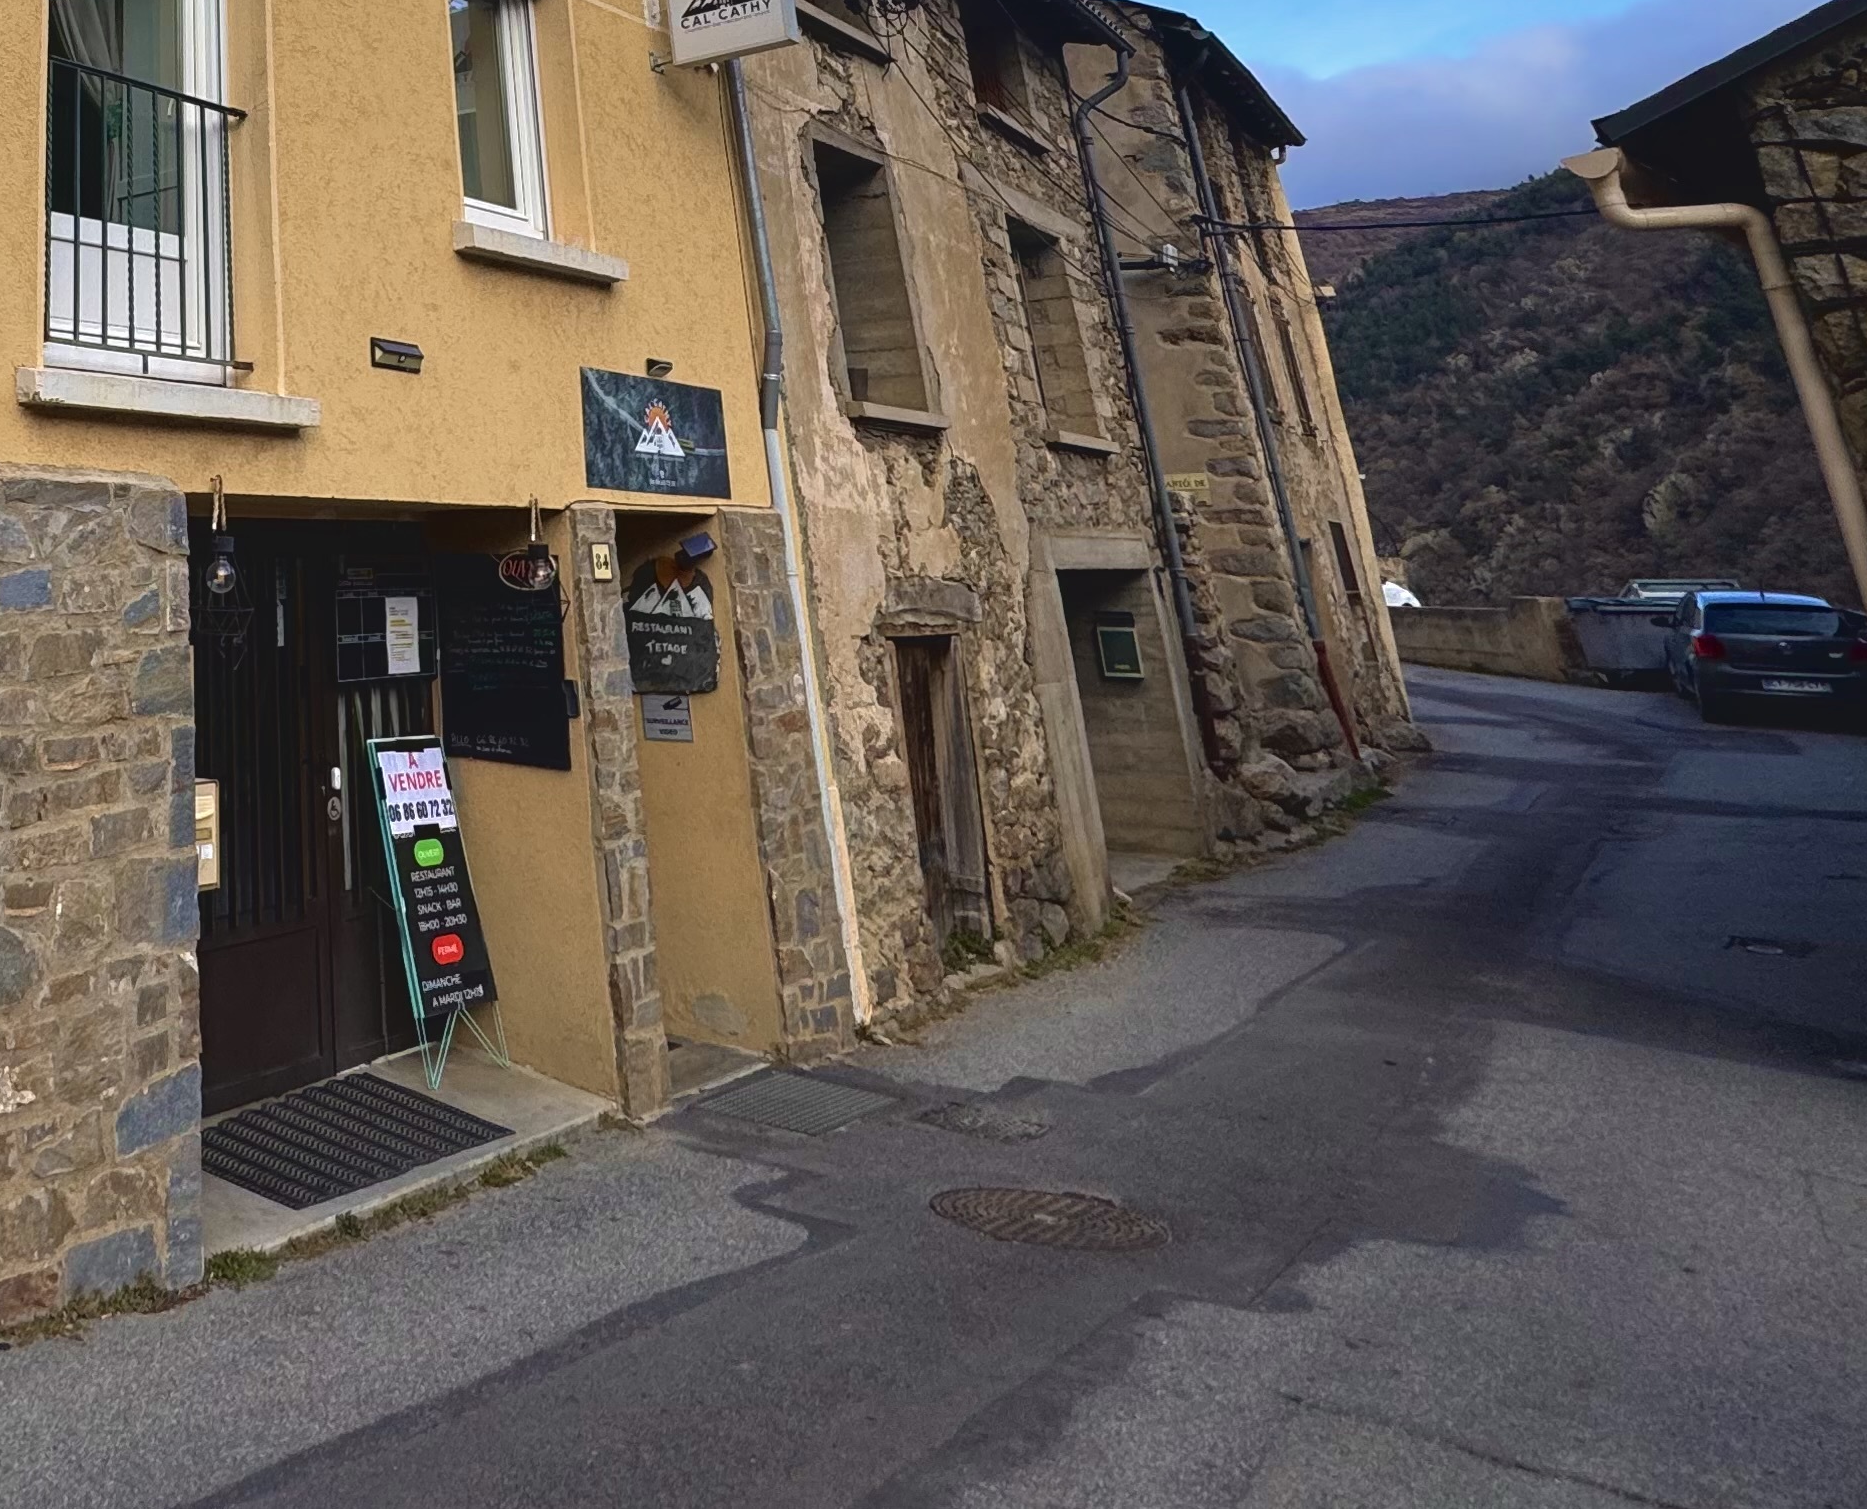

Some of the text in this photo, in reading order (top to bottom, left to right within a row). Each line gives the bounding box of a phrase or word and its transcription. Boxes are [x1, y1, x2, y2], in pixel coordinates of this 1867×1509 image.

[595, 553, 609, 570] 84
[632, 621, 693, 636] RESTAURANT
[387, 770, 443, 792] VENDRE
[388, 798, 454, 822] 06 86 60 72 32
[410, 866, 455, 882] RESTAURANT
[417, 901, 442, 915] SNACK
[446, 897, 462, 910] BAR
[421, 973, 462, 992] DIMANCHE
[438, 990, 463, 1005] MARDI
